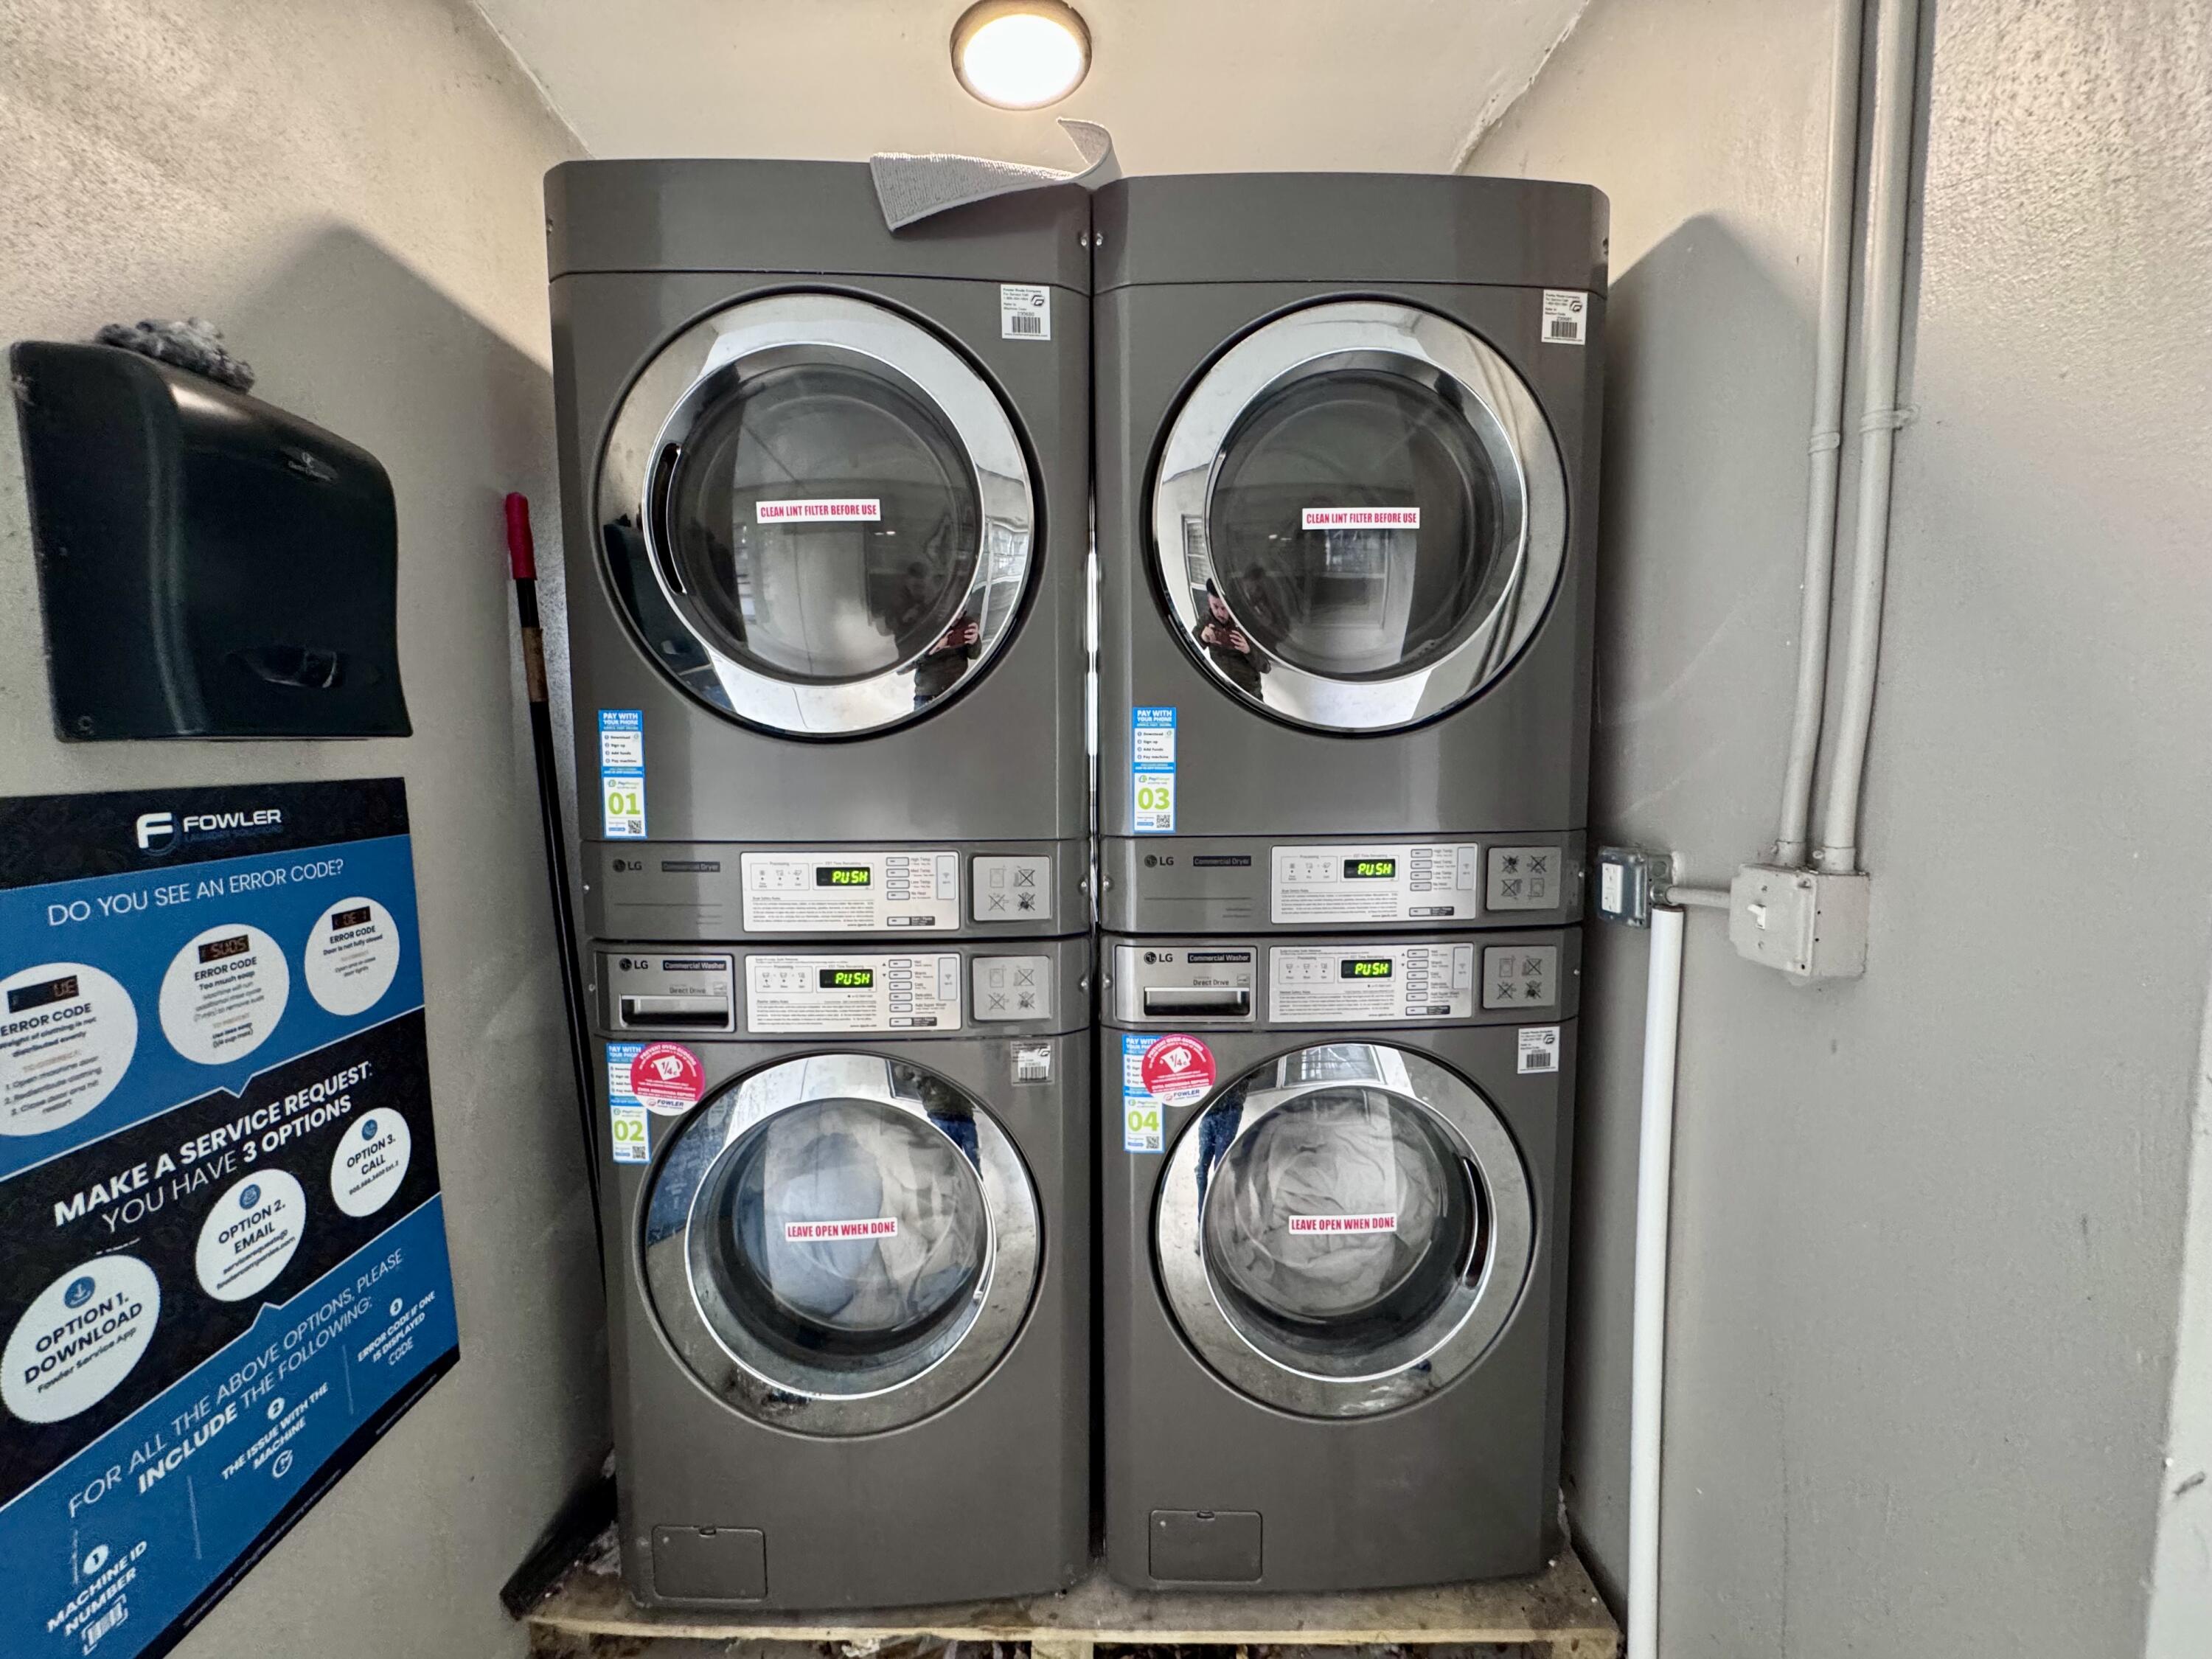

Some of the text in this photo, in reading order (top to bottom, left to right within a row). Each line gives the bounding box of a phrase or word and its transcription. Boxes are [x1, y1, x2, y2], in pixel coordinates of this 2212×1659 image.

[761, 504, 877, 518] CLEAN LINT FILTER BEFORE USE
[1307, 513, 1416, 524] CLEAN LINT FILTER BEFORE USE
[608, 792, 641, 815] 01
[1138, 787, 1170, 810] 03
[184, 809, 282, 832] FOWLER
[627, 861, 642, 871] LG
[1159, 857, 1174, 866] LG
[1232, 858, 1250, 866] Dryer
[1357, 863, 1392, 875] PUSH
[832, 871, 869, 884] PUSH
[48, 859, 344, 926] DO YOU SEE AN ERROR CODE?
[330, 925, 376, 945] ERROR CODE
[194, 956, 258, 981] ERROR CODE
[634, 961, 648, 969] LG
[1159, 953, 1173, 962] LG
[1354, 963, 1388, 975] PUSH
[199, 981, 214, 991] Too
[215, 975, 237, 987] much
[835, 973, 870, 985] PUSH
[0, 1003, 92, 1037] ERROR CODE
[13, 1076, 37, 1088] Open
[1174, 1089, 1200, 1097] FOWLER
[613, 1119, 645, 1141] 02
[1128, 1110, 1160, 1132] 04
[54, 1061, 373, 1227] MAKE A SERVICE REQUEST:
[347, 1134, 397, 1168] OPTION 3.
[102, 1094, 352, 1233] YOU HAVE 3 OPTIONS
[361, 1155, 386, 1175] CALL
[218, 1199, 286, 1244] OPTION 2.
[787, 1222, 895, 1237] LEAVE OPEN WHEN DONE
[1291, 1217, 1394, 1230] LEAVE OPEN WHEN DONE
[234, 1222, 276, 1253] EMAIL
[35, 1292, 129, 1352] OPTION 1.
[358, 1290, 436, 1362] ERROR CODE IF ONE
[24, 1302, 142, 1385] DOWNLOAD
[372, 1312, 425, 1363] IS DISPLAYED
[38, 1327, 137, 1394] Fowler Service App
[388, 1336, 414, 1366] CODE
[69, 1248, 403, 1520] FOR ALL THE ABOVE OPTIONS, PLEASE
[138, 1406, 237, 1497] INCLUDE
[241, 1371, 276, 1410] THE
[279, 1295, 374, 1381] FOLLOWING:
[221, 1382, 329, 1480] THE ISSUE WITH THE
[254, 1416, 307, 1470] MACHINE
[47, 1540, 147, 1632] MACHINE ID
[65, 1566, 137, 1638] NUMBER
